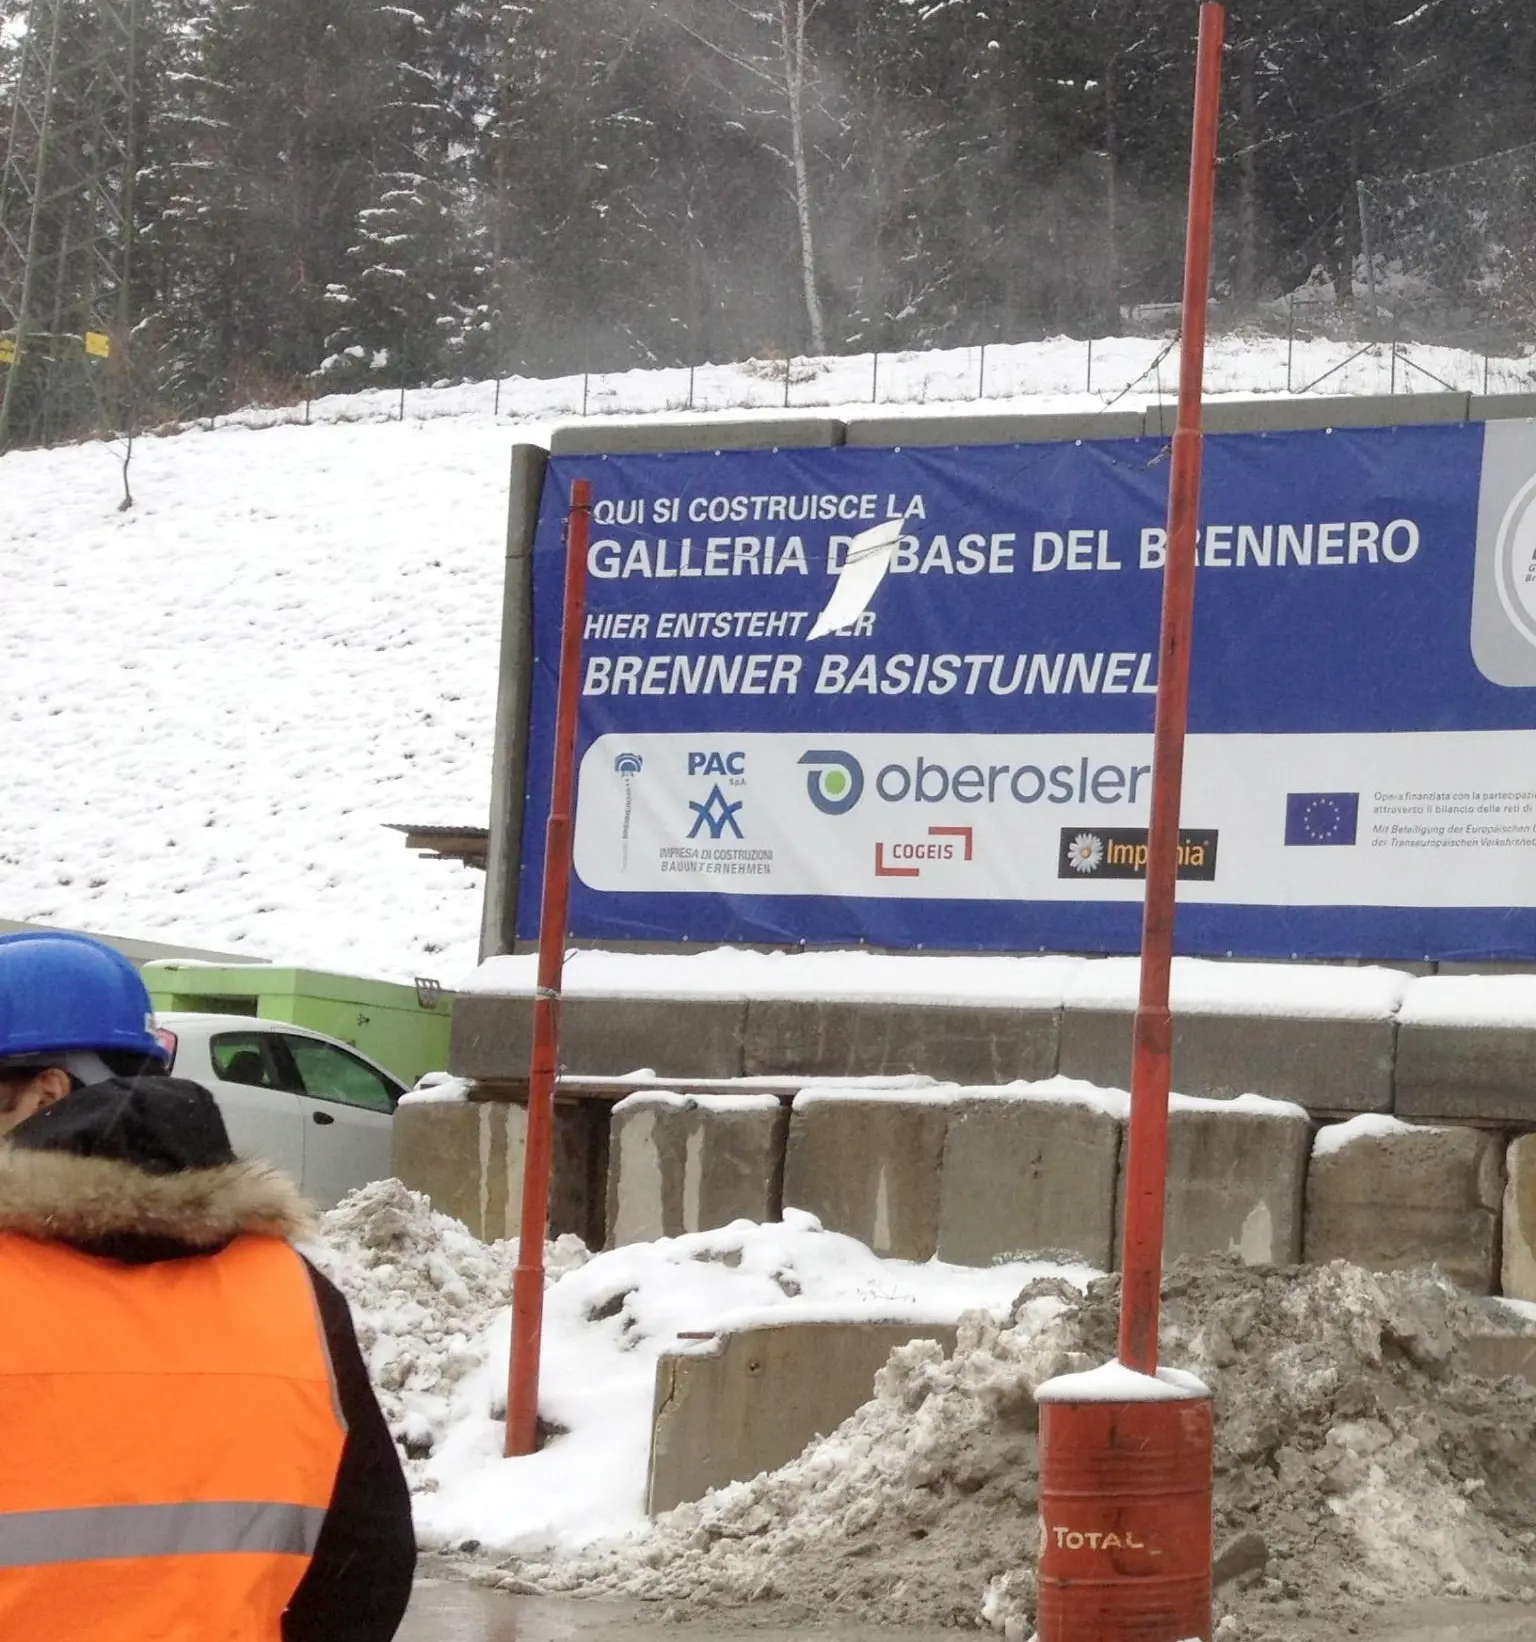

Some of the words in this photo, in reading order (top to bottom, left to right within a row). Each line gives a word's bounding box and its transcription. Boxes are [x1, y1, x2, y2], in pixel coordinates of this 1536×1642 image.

[594, 500, 644, 524] QUI
[653, 498, 680, 523] SI
[689, 494, 877, 522] COSTRUISCE
[886, 494, 926, 520] LA
[587, 536, 809, 578] GALLERIA
[889, 533, 1016, 574] BASE
[1032, 530, 1121, 572] DEL
[1139, 519, 1419, 569] BENNERO
[584, 614, 649, 640] HIER
[656, 612, 807, 639] ENTSTEHT
[582, 656, 802, 696] BRENNER
[814, 653, 1159, 695] BASISTUNNEL
[688, 752, 745, 776] PAC
[875, 756, 1150, 804] oberosler
[893, 843, 954, 861] COGEIS
